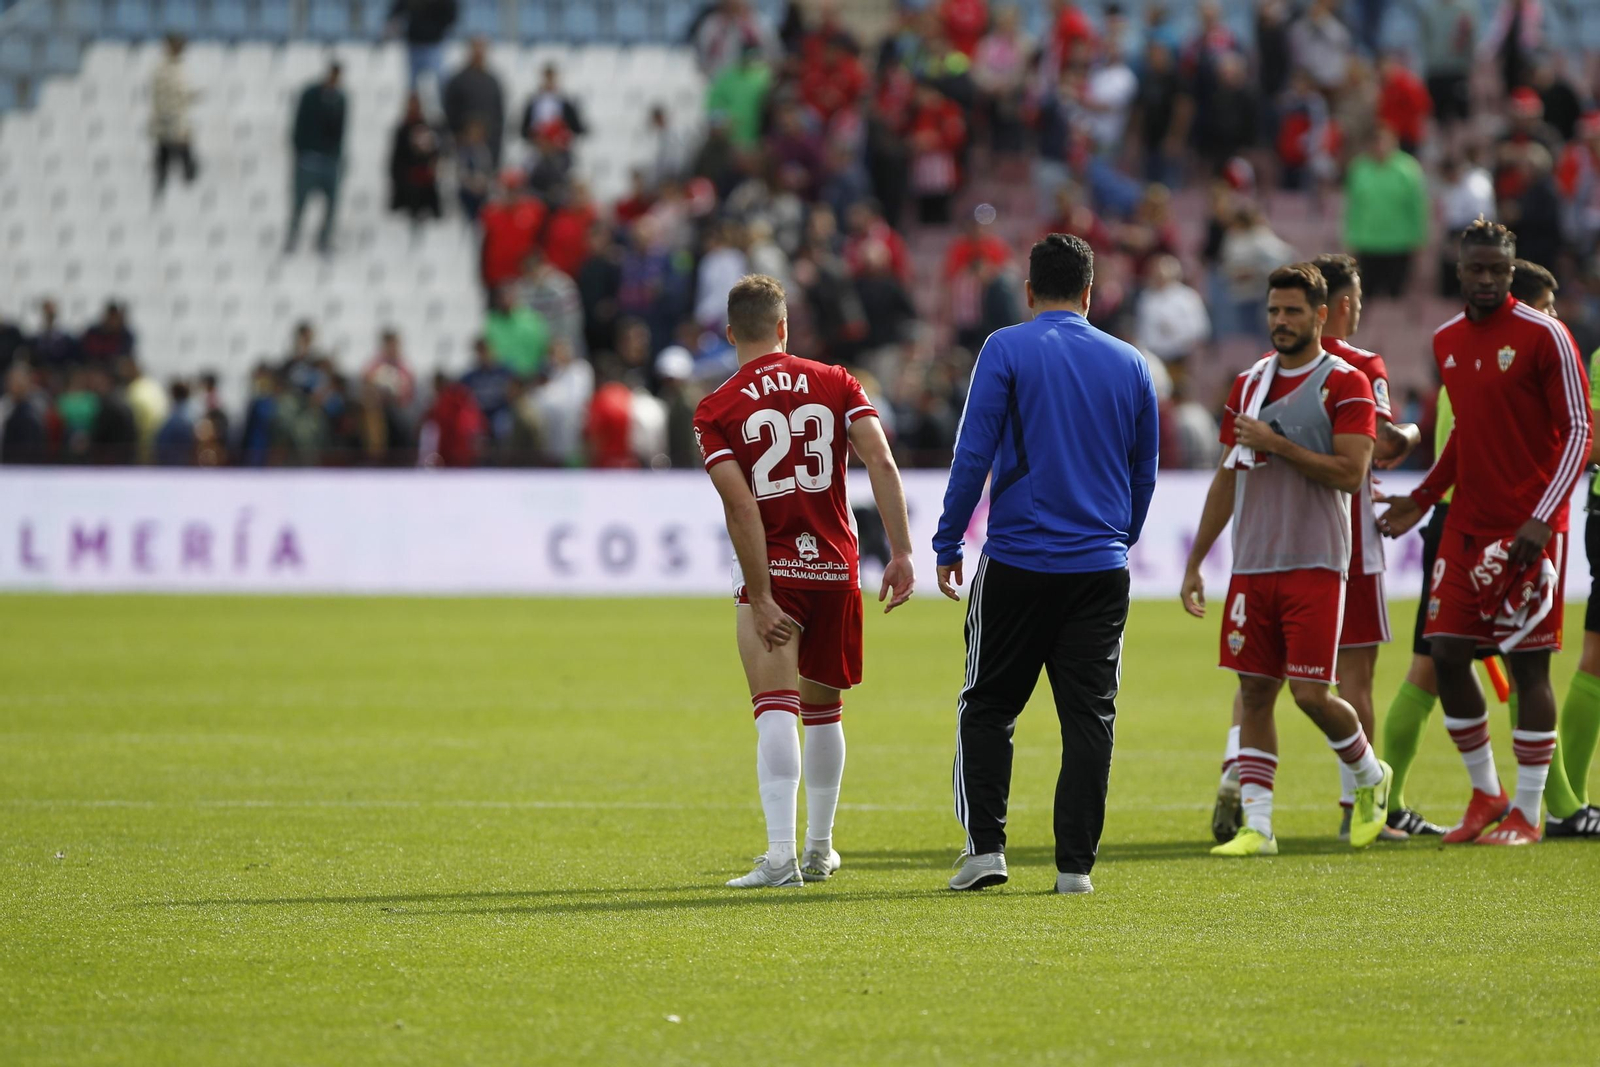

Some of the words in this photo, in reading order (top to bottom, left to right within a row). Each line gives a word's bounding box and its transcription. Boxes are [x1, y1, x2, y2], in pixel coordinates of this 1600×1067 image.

[740, 371, 809, 401] VADA
[741, 403, 835, 501] 23
[769, 568, 792, 577] ABDUL
[792, 569, 816, 580] SAMAD
[1431, 558, 1446, 592] 9
[1230, 592, 1247, 628] 4
